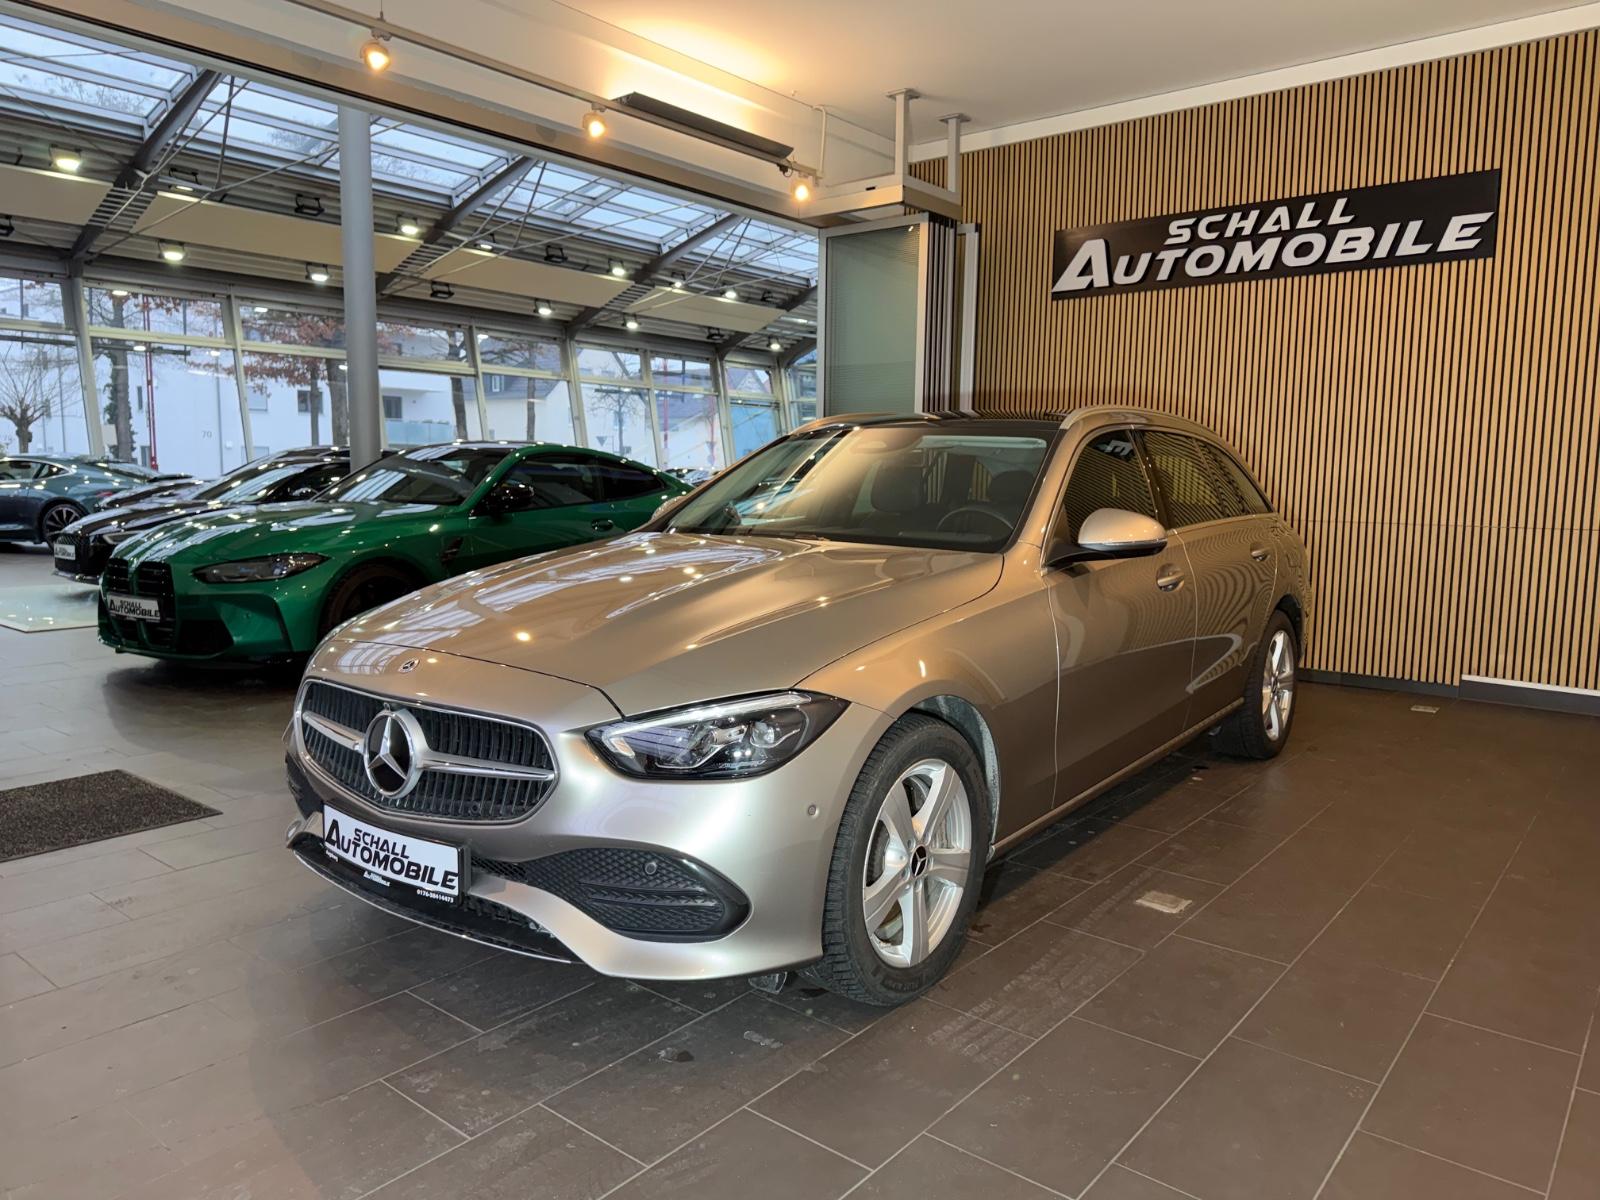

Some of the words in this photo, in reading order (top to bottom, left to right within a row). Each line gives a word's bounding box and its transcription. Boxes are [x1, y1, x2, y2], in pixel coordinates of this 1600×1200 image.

[1164, 197, 1355, 245] SCHALL
[1051, 211, 1495, 293] AUTOMOBILE
[325, 818, 459, 890] AUTOMOBILE
[353, 828, 410, 860] SCHALL
